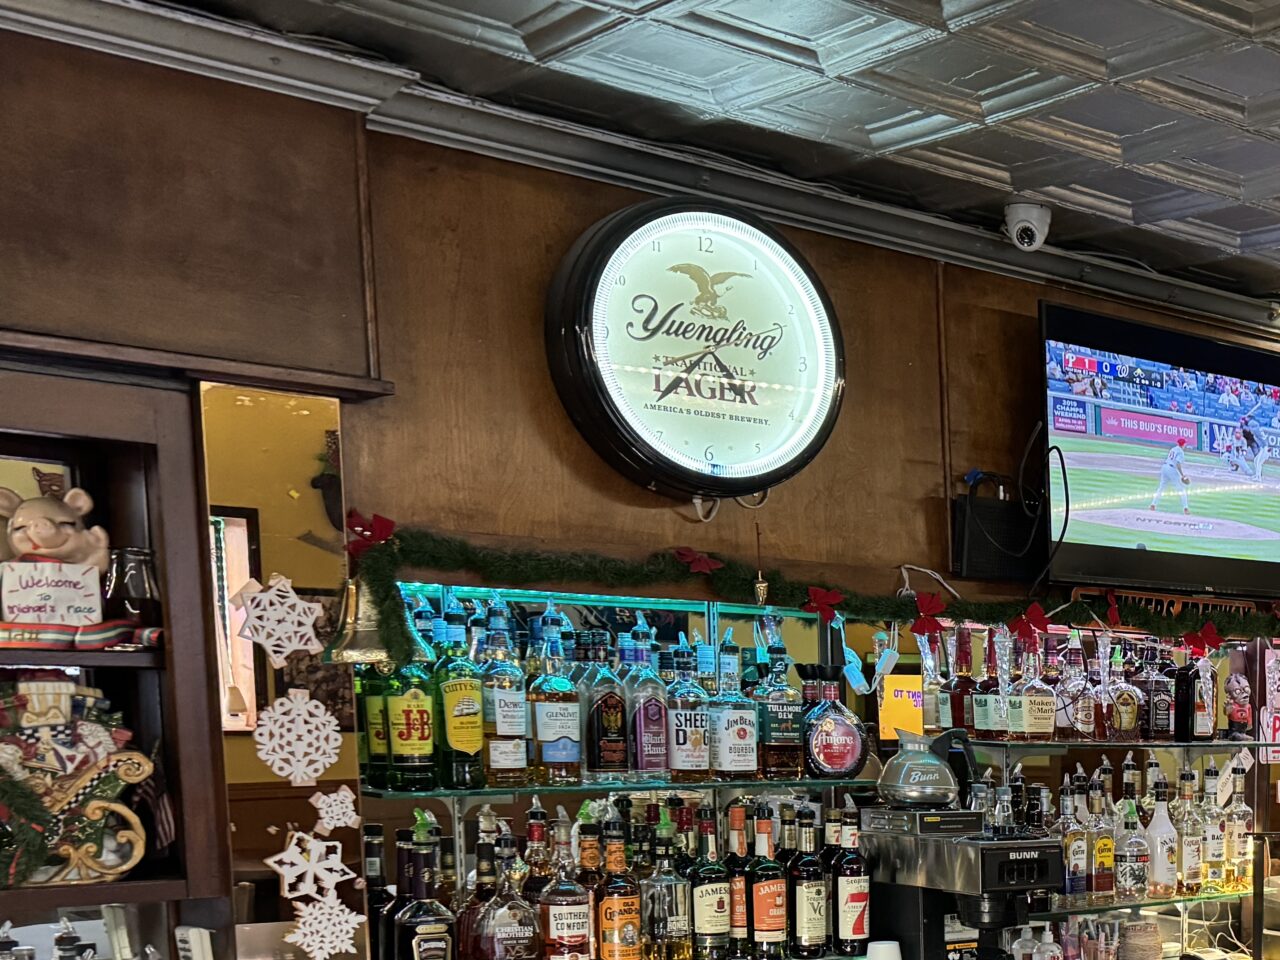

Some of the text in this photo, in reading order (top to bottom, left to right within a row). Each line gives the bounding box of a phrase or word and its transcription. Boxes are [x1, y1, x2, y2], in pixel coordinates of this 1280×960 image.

[697, 236, 713, 253] 12
[626, 294, 783, 360] Yuengling
[798, 357, 807, 372] 3
[643, 403, 691, 415] AMERICA'S
[694, 409, 726, 420] OLDEST
[1120, 418, 1194, 438] THIS BUD'S FOR YOU
[705, 445, 714, 461] 6
[19, 575, 85, 590] Welcome
[444, 683, 466, 694] CUTTY
[498, 699, 523, 709] Dewa
[725, 718, 738, 731] JIM
[675, 729, 708, 745] DG
[729, 746, 755, 754] BOURBON
[909, 771, 940, 783] Bunn
[850, 833, 858, 846] 7
[1160, 838, 1176, 847] MAL
[1009, 852, 1039, 860] BUNN
[699, 887, 730, 898] JAMES
[758, 884, 785, 895] JAMES
[844, 892, 869, 936] 7
